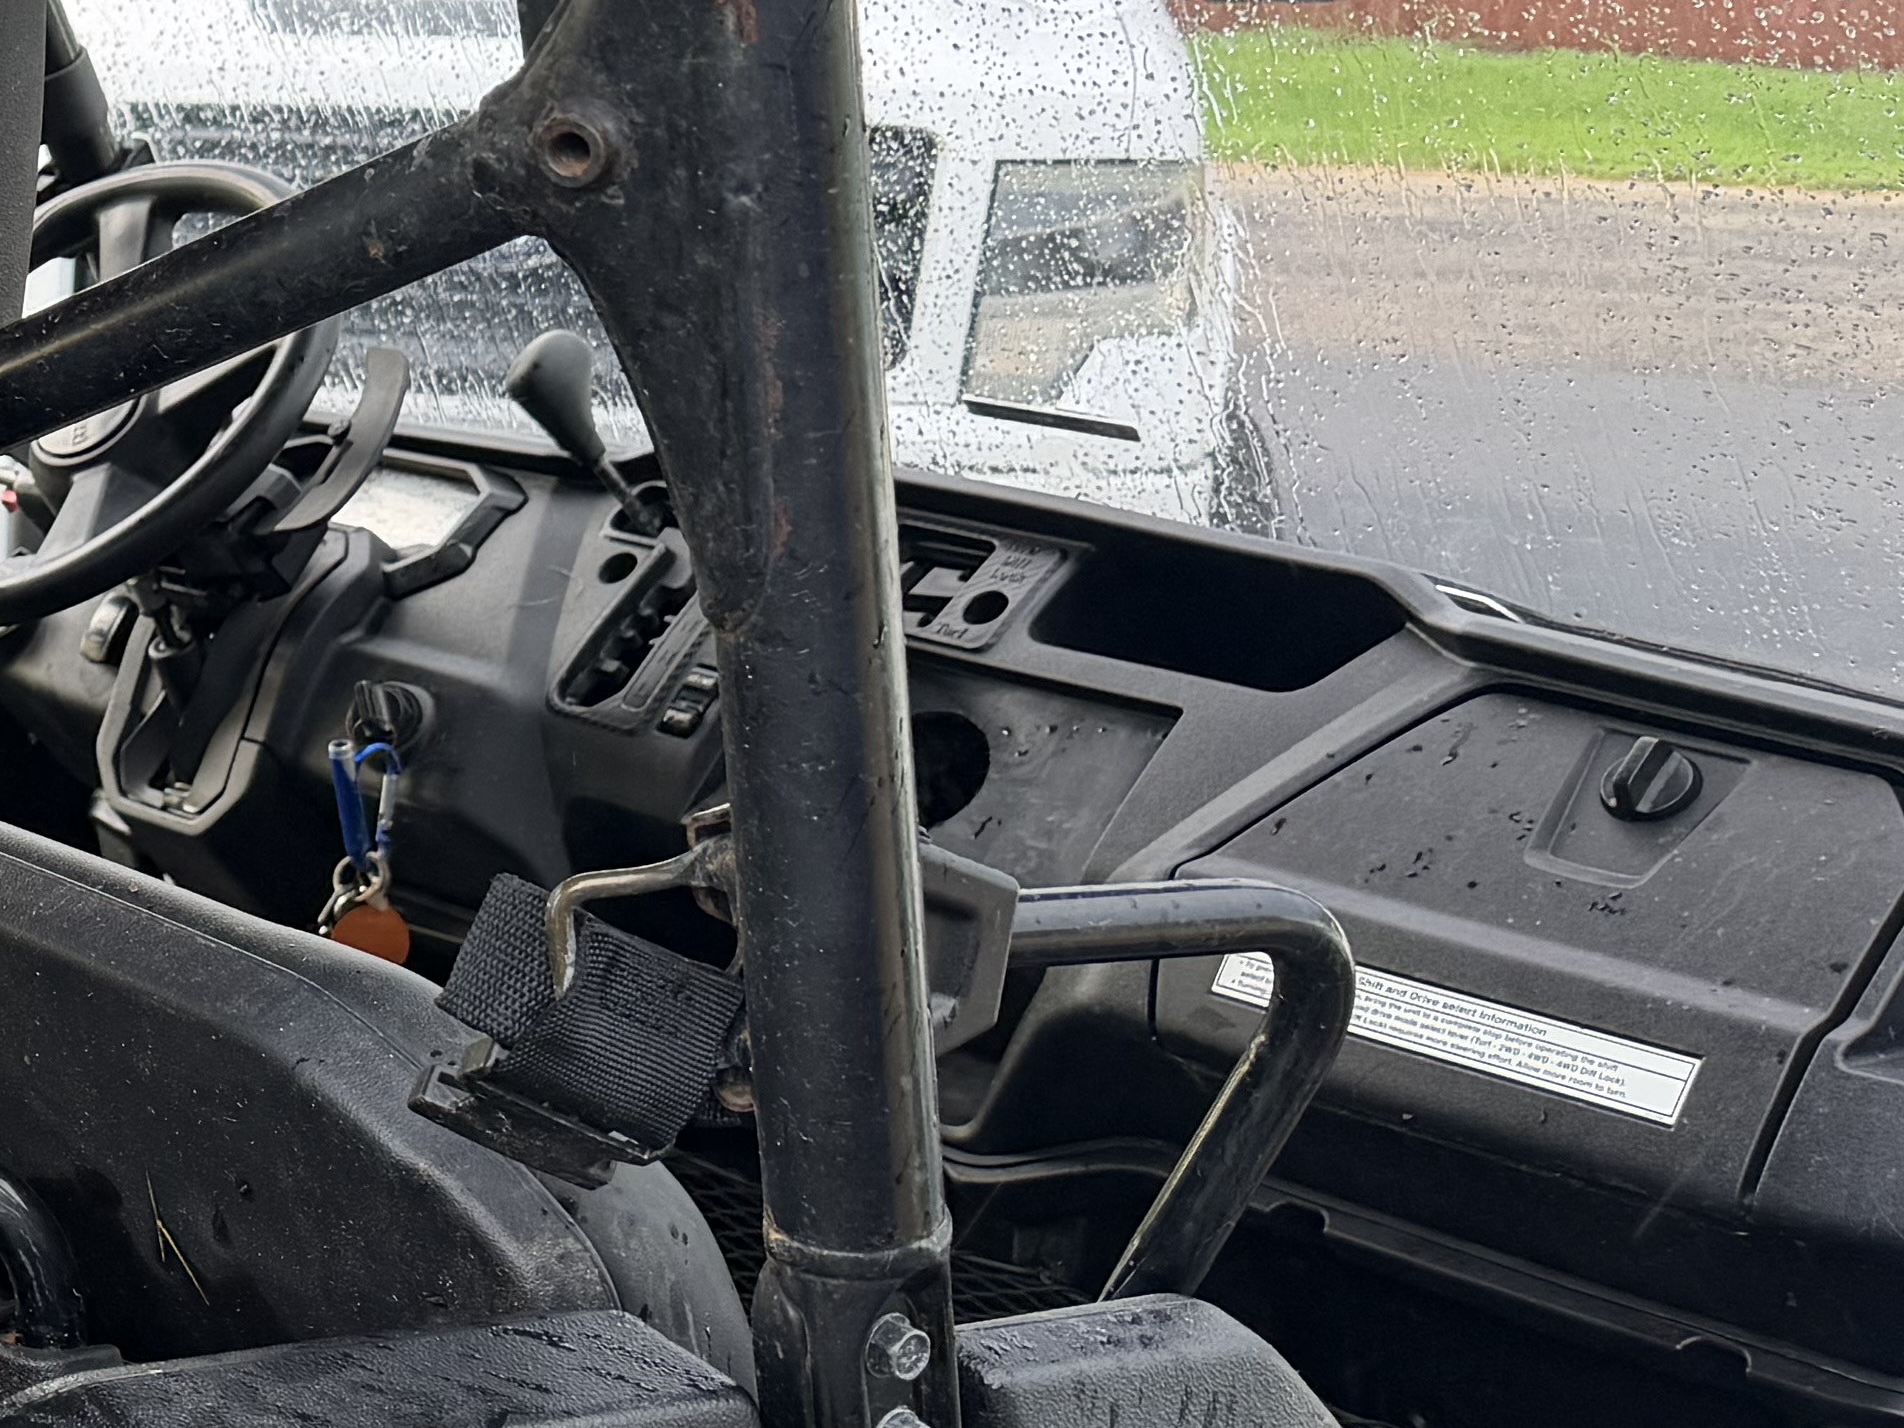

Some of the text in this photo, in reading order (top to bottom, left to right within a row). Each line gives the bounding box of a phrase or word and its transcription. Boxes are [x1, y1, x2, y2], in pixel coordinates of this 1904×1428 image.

[1358, 976, 1384, 992] Shift
[1385, 985, 1408, 998] and
[1410, 991, 1441, 1007] Drive
[1479, 1010, 1548, 1037] Information
